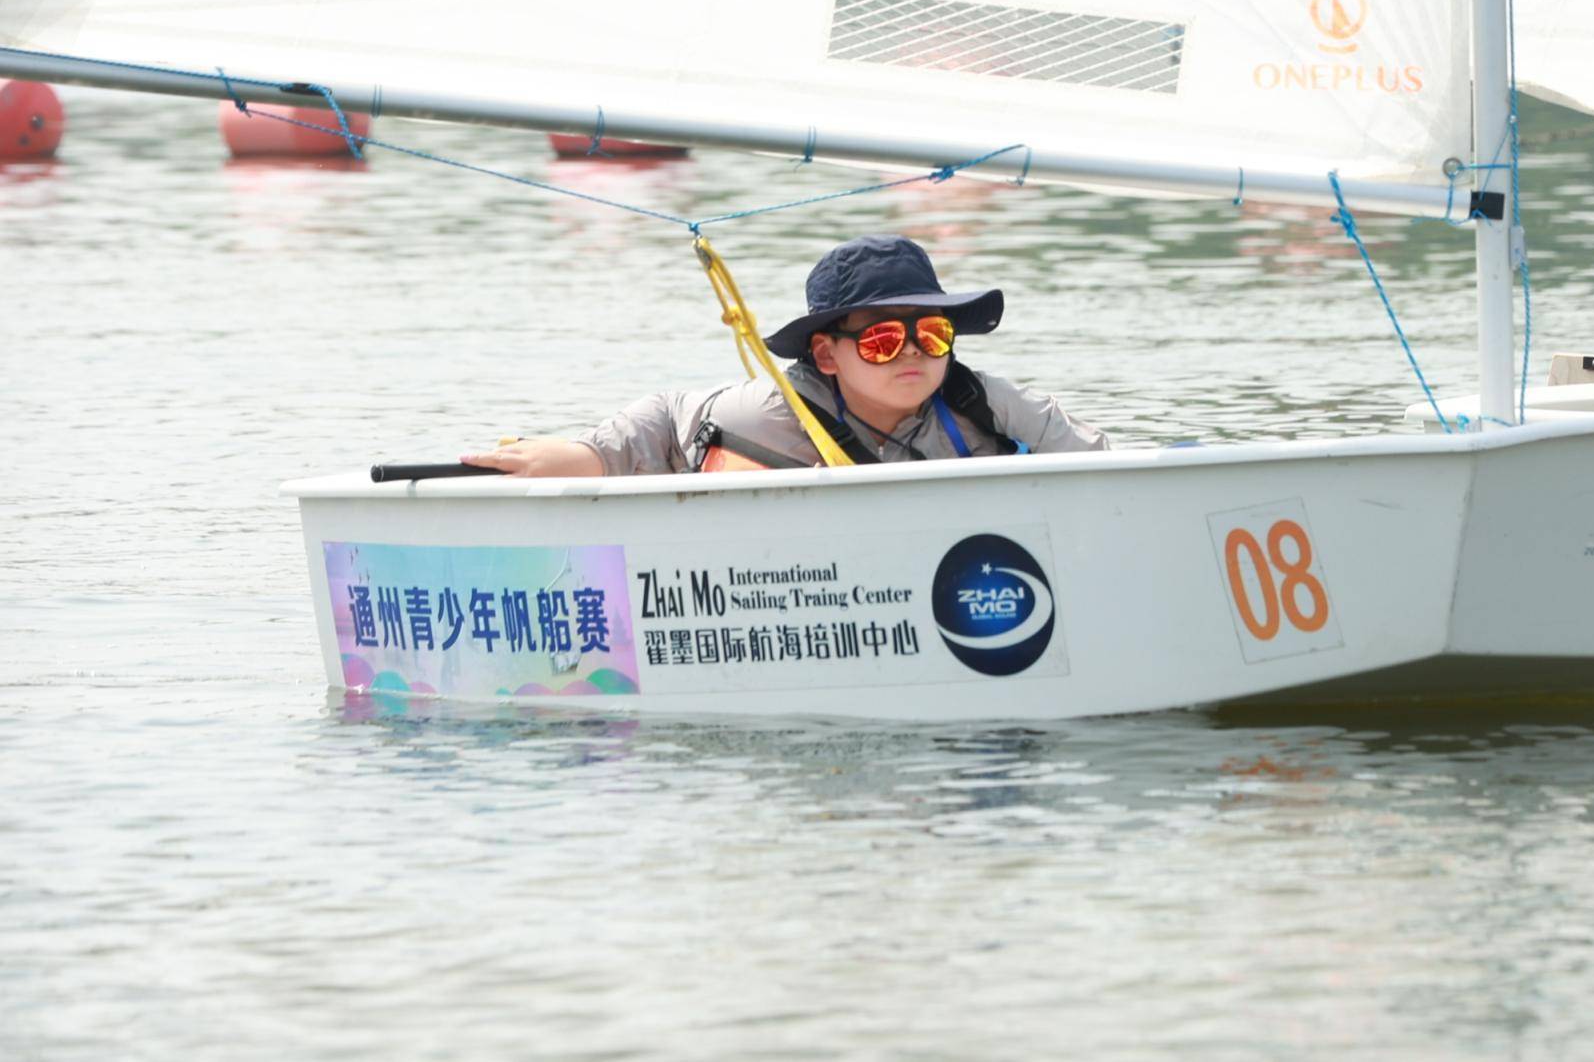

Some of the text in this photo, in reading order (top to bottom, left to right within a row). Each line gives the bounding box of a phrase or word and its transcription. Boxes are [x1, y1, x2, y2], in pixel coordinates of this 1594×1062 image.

[1253, 63, 1423, 92] ONEPLUS
[728, 562, 838, 586] International
[1225, 519, 1329, 641] 08
[731, 585, 912, 612] Sailing Traing Center
[957, 587, 1024, 603] ZHAI
[969, 600, 1017, 615] MO
[347, 584, 610, 653] 通州青少年帆船赛
[645, 619, 920, 666] 翟墨国际航海培训中心
